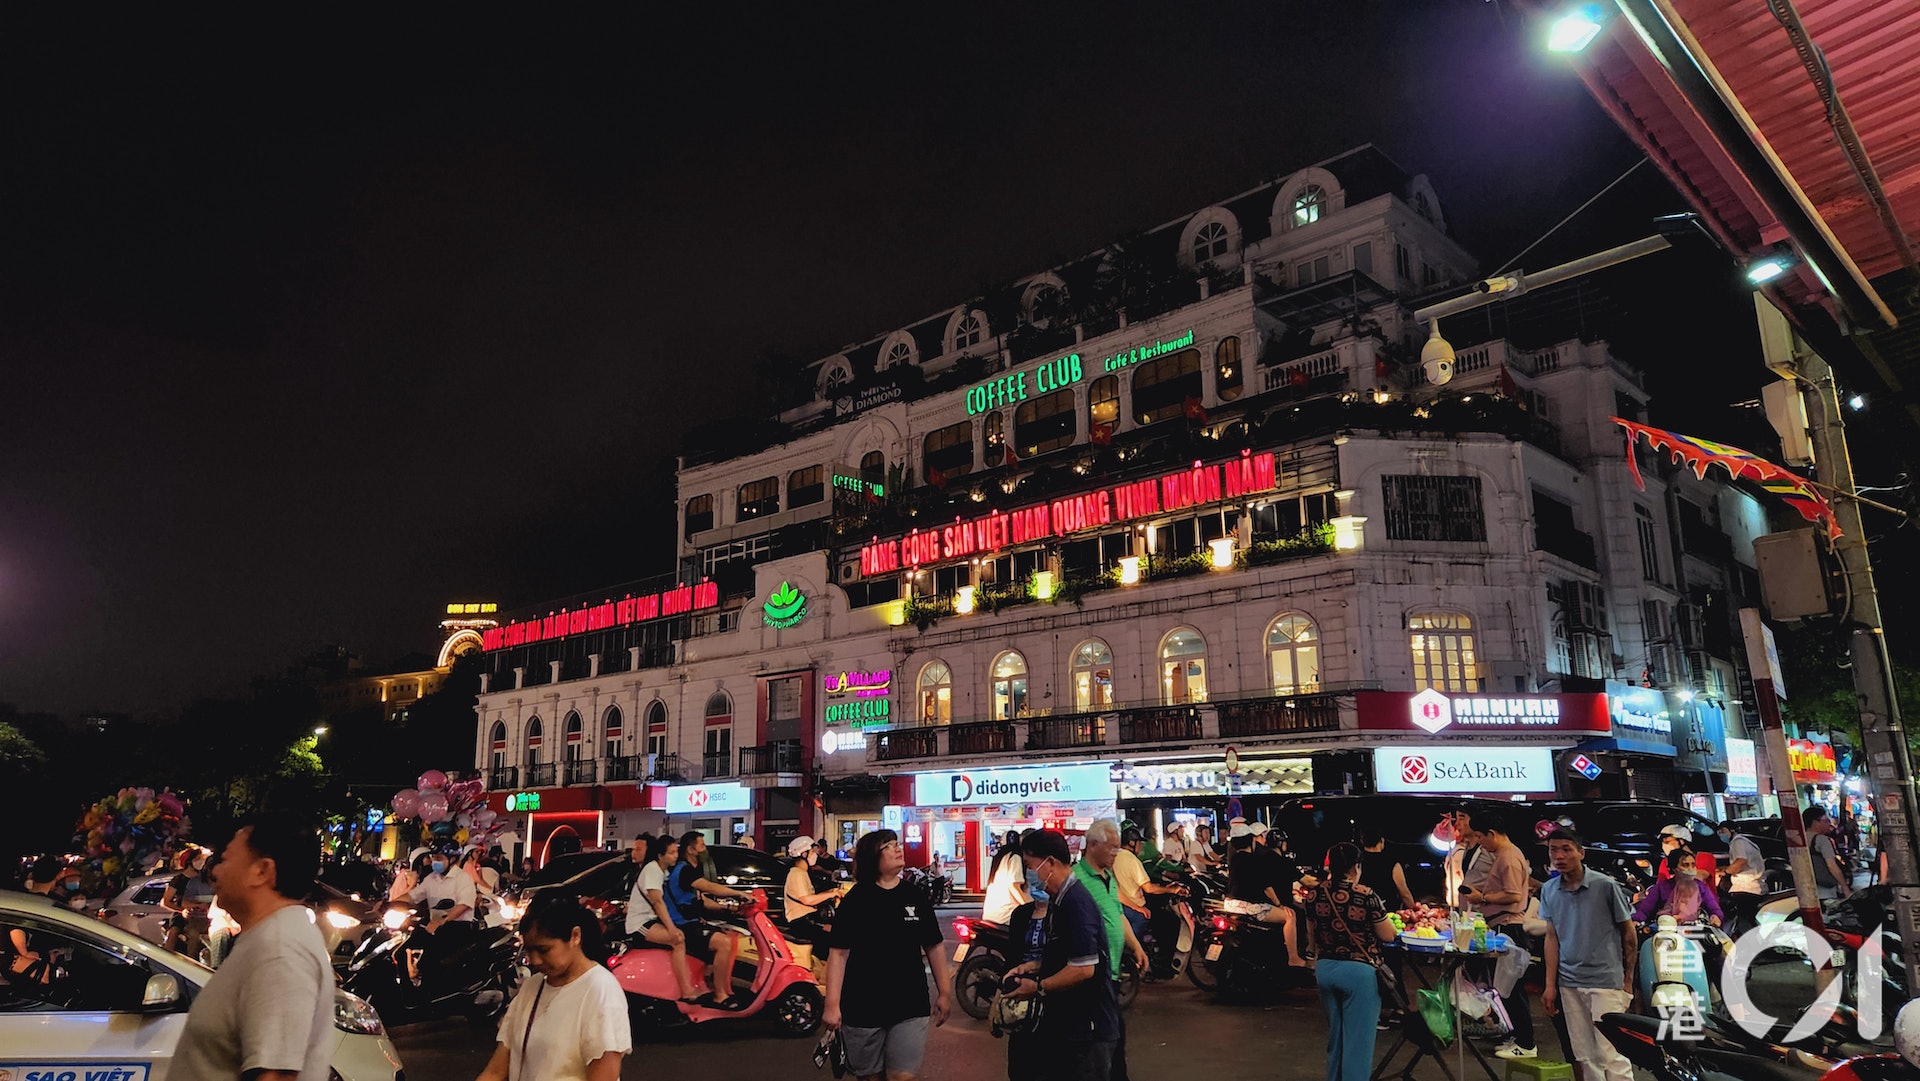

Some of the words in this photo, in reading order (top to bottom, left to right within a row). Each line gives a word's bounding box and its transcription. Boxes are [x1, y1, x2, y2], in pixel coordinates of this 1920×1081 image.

[1104, 353, 1128, 373] Café
[1130, 349, 1138, 364] &
[1139, 329, 1194, 361] Restaurant
[965, 371, 1028, 416] COFFEE
[1036, 353, 1083, 393] CLUB
[856, 387, 902, 410] DIAMOND
[861, 535, 898, 576] ĐẢNG
[902, 527, 939, 571] CỘNG
[944, 515, 974, 558] SẢN
[976, 508, 1009, 553] VIỆT
[1012, 504, 1049, 544] NAM
[1052, 489, 1110, 537] QUANG
[1114, 479, 1159, 520] VINH
[1162, 460, 1221, 511] MUÔN
[1224, 448, 1276, 498] NĂM
[826, 702, 861, 722] COFFEE
[863, 698, 889, 717] CLUB
[1454, 698, 1559, 716] MANWAH
[1457, 716, 1516, 724] TAIWANESE
[1520, 716, 1559, 725] HOTPOT
[1148, 770, 1216, 790] VERTU
[1434, 760, 1528, 779] SeABank
[709, 792, 727, 801] HSBC
